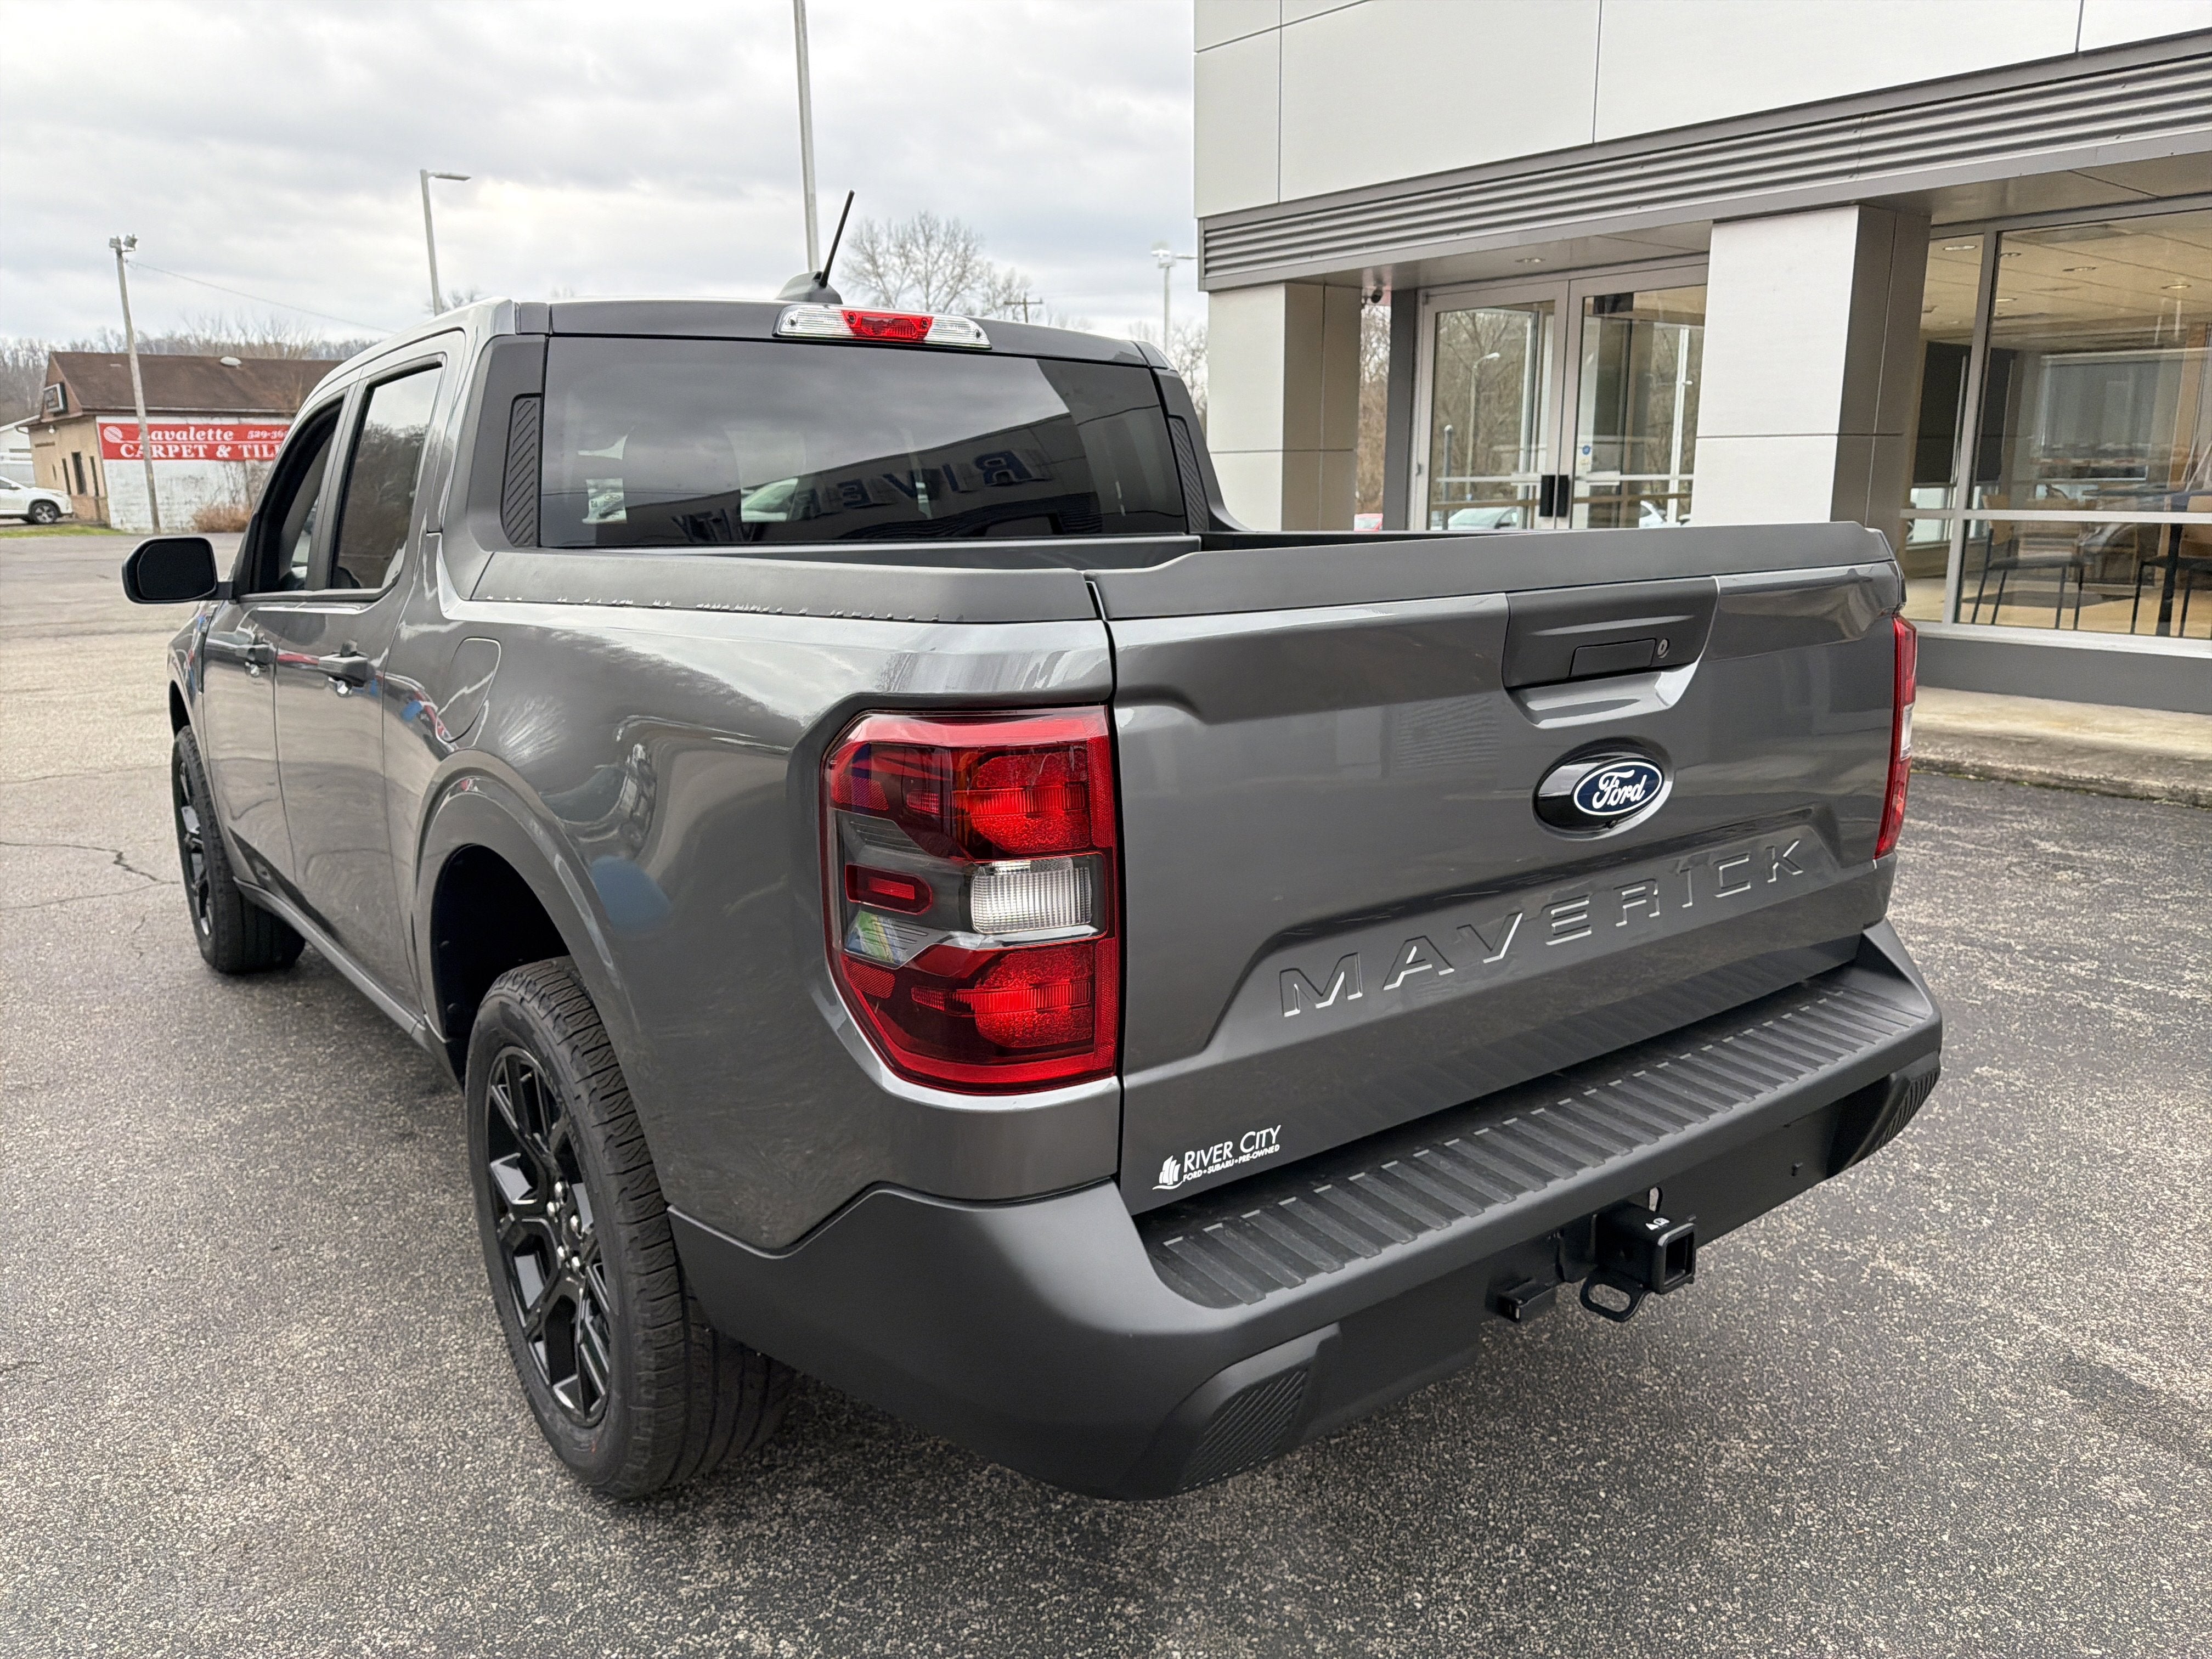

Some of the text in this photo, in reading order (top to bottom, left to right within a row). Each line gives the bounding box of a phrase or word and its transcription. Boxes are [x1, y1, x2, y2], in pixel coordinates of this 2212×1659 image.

[137, 426, 234, 441] avalette
[216, 444, 232, 458] &
[1592, 769, 1647, 809] Ford
[1279, 838, 1804, 1017] MAVERICK
[1183, 1125, 1282, 1173] RIVER CITY
